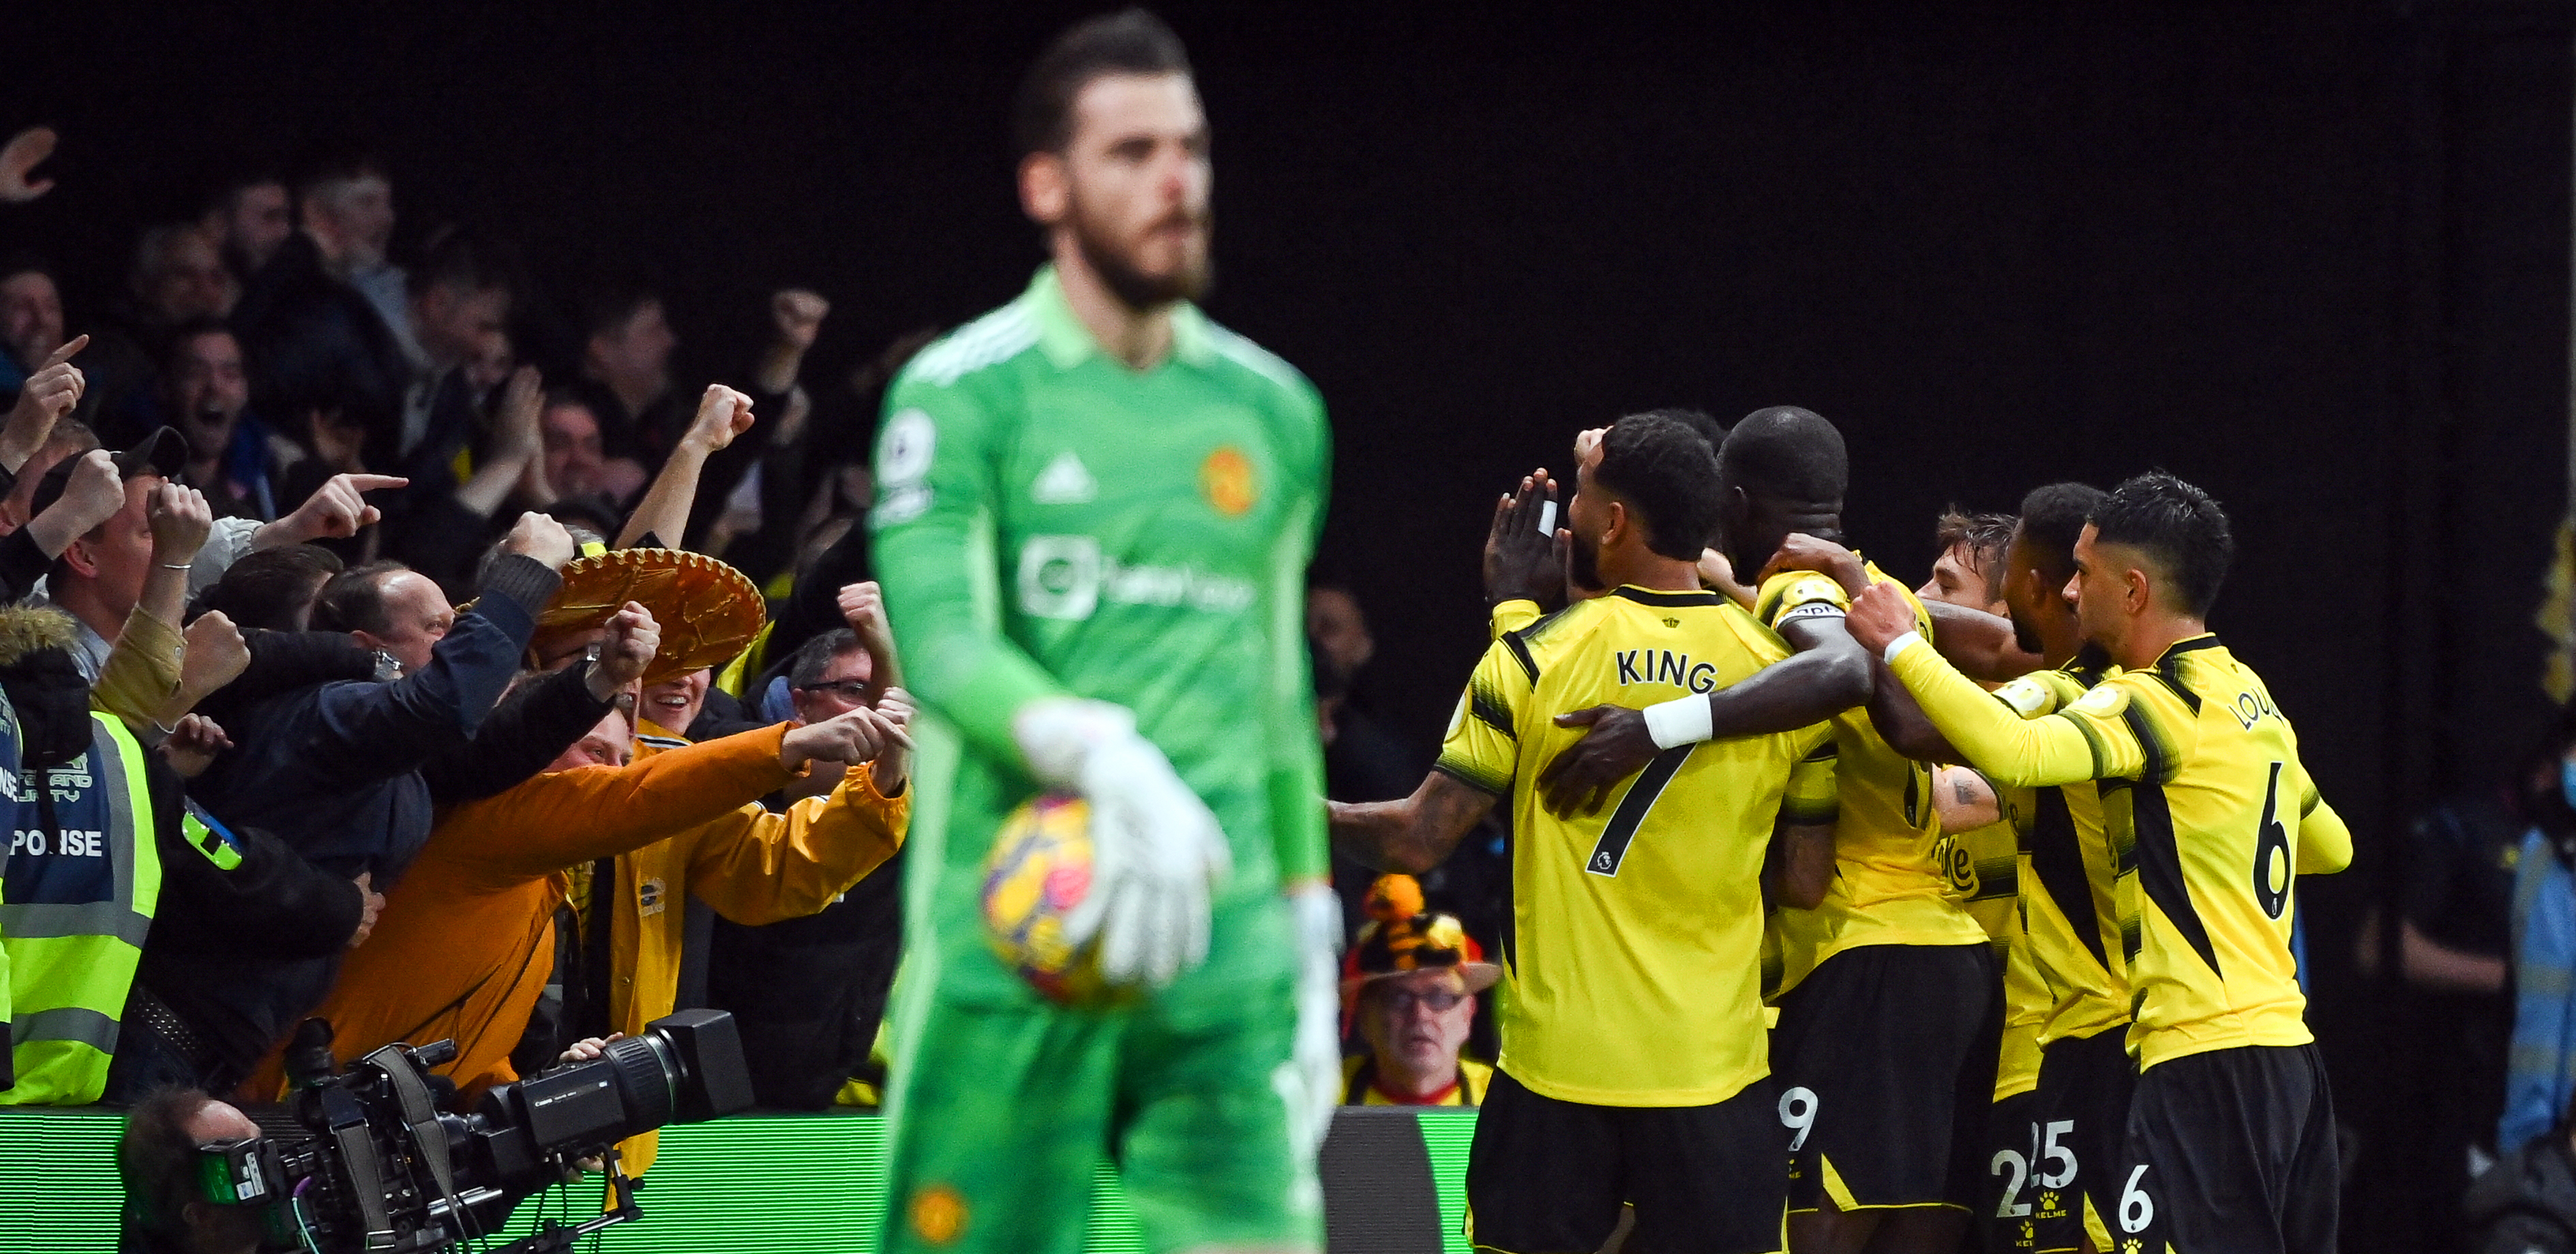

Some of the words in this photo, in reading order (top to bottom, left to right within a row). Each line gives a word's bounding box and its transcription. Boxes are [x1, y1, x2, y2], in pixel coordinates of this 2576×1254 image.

[1616, 649, 1717, 693] KING
[49, 775, 93, 788] AND
[1585, 742, 1700, 878] 7
[2253, 762, 2292, 921] 6
[1778, 1087, 1819, 1151] 9
[1991, 1150, 2032, 1218] 2
[2036, 1209, 2067, 1219] KELME
[2119, 1165, 2154, 1234] 6
